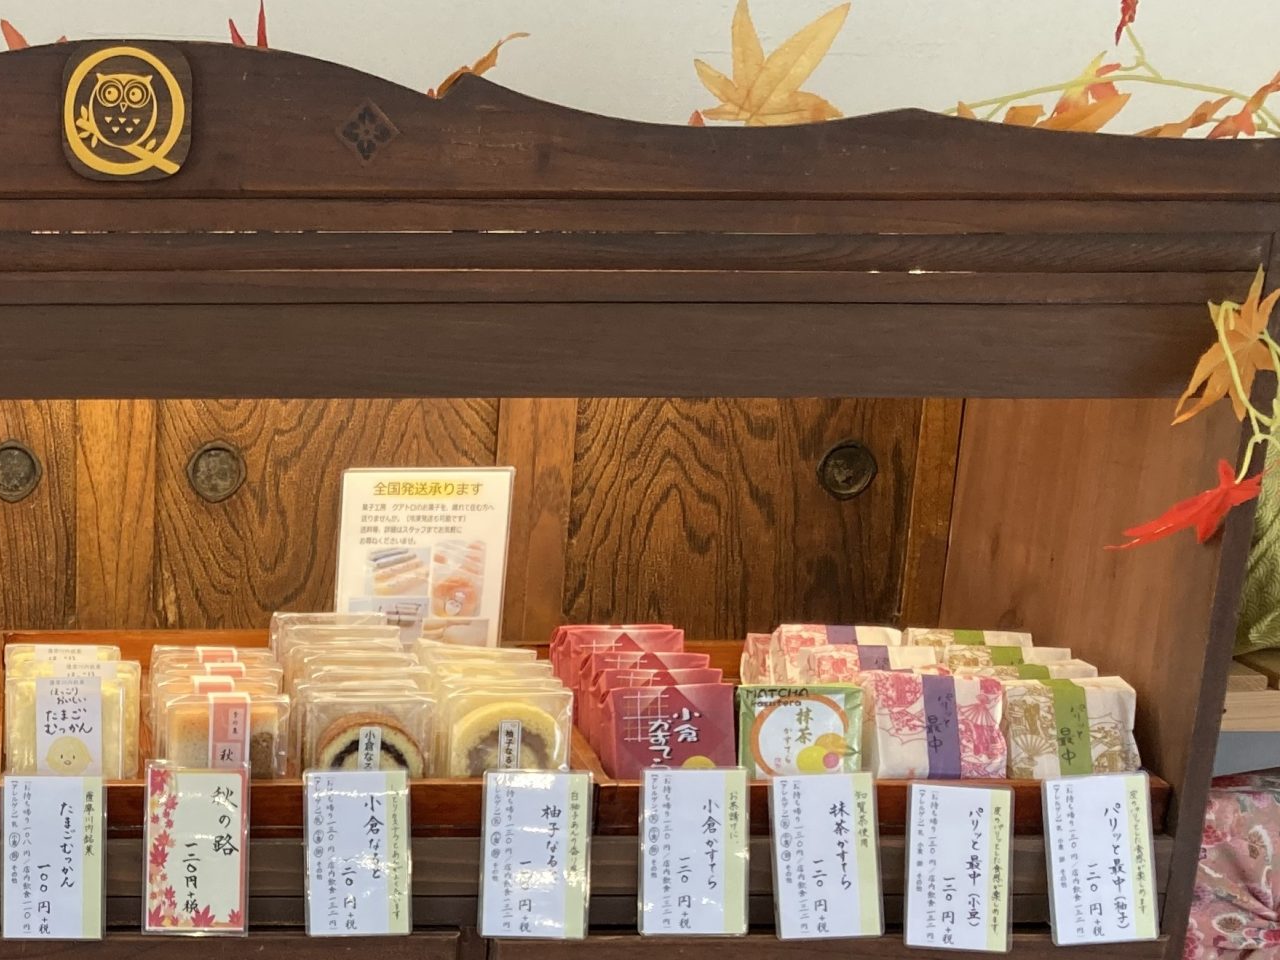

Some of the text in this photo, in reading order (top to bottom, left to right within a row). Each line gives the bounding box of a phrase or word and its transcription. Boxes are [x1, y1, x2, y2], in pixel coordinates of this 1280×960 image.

[373, 481, 484, 496] 全国発送承ります
[746, 688, 809, 699] MATCHA
[673, 708, 701, 743] 小倉
[795, 707, 815, 745] 抹茶
[926, 714, 943, 752] 最中
[219, 748, 234, 762] 秋
[505, 730, 514, 769] 柚子なる
[1058, 726, 1077, 764] 最中
[83, 791, 95, 857] 薩摩川内銘菓
[211, 786, 240, 857] 秋の路
[363, 795, 384, 880] 小倉なると
[60, 802, 76, 889] たまごむっかん
[702, 798, 721, 890] 小倉かすてら
[829, 801, 852, 891] 抹茶かすてら
